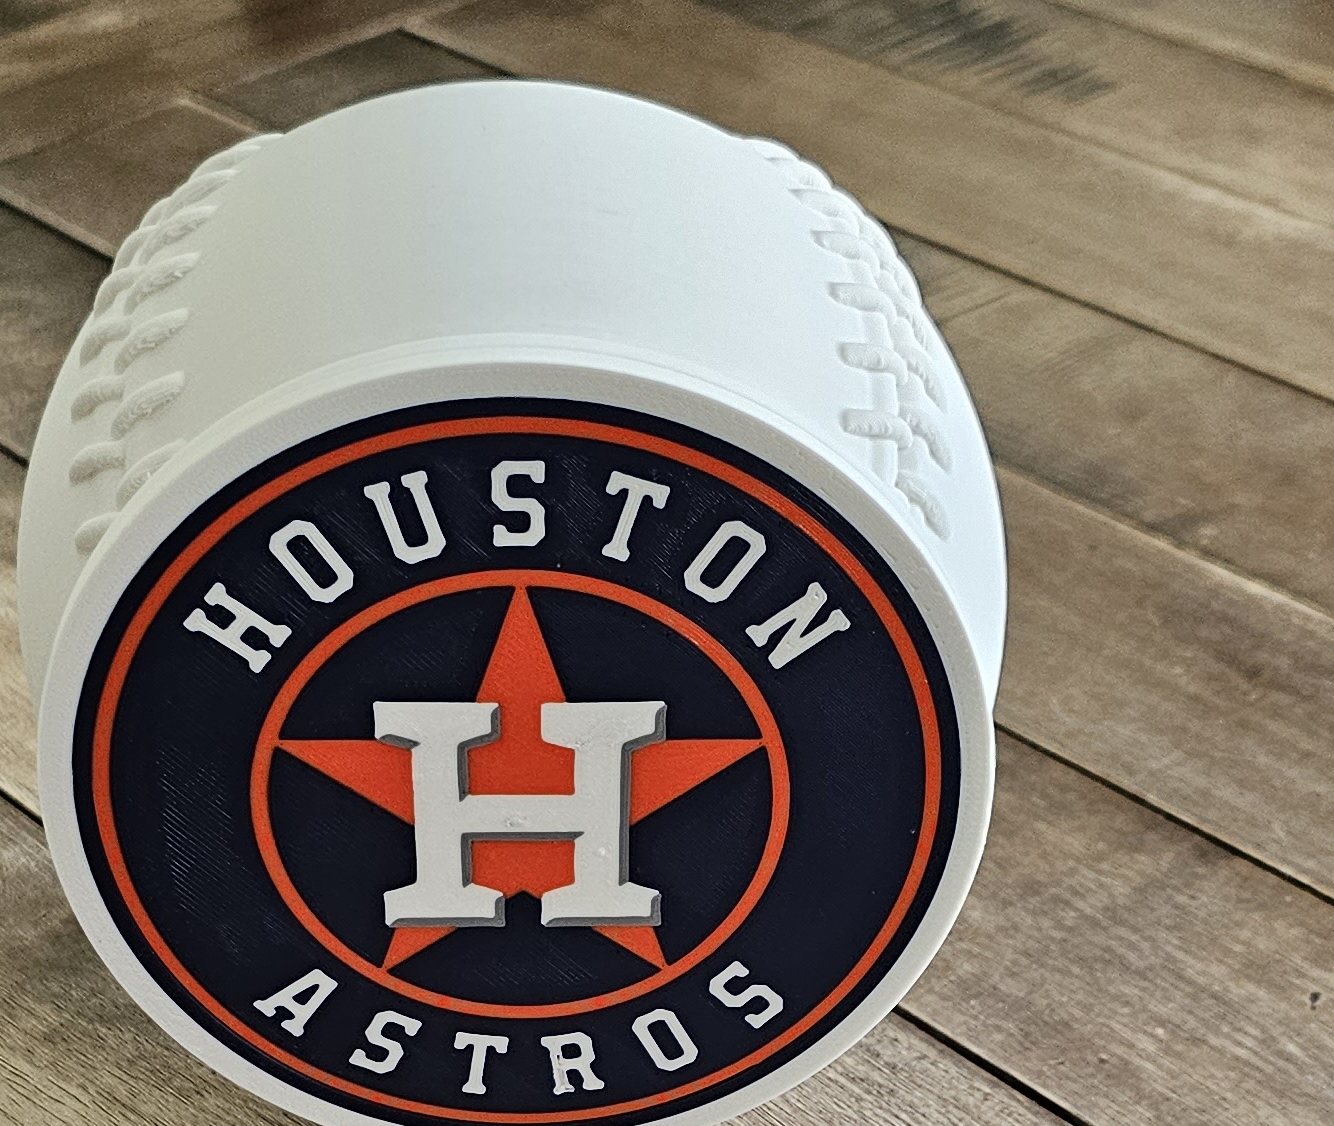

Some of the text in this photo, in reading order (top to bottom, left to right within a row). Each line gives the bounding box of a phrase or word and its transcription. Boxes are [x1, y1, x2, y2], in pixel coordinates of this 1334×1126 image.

[183, 460, 851, 673] HOUSTON
[373, 701, 666, 928] H
[254, 962, 783, 1094] ASTROS
